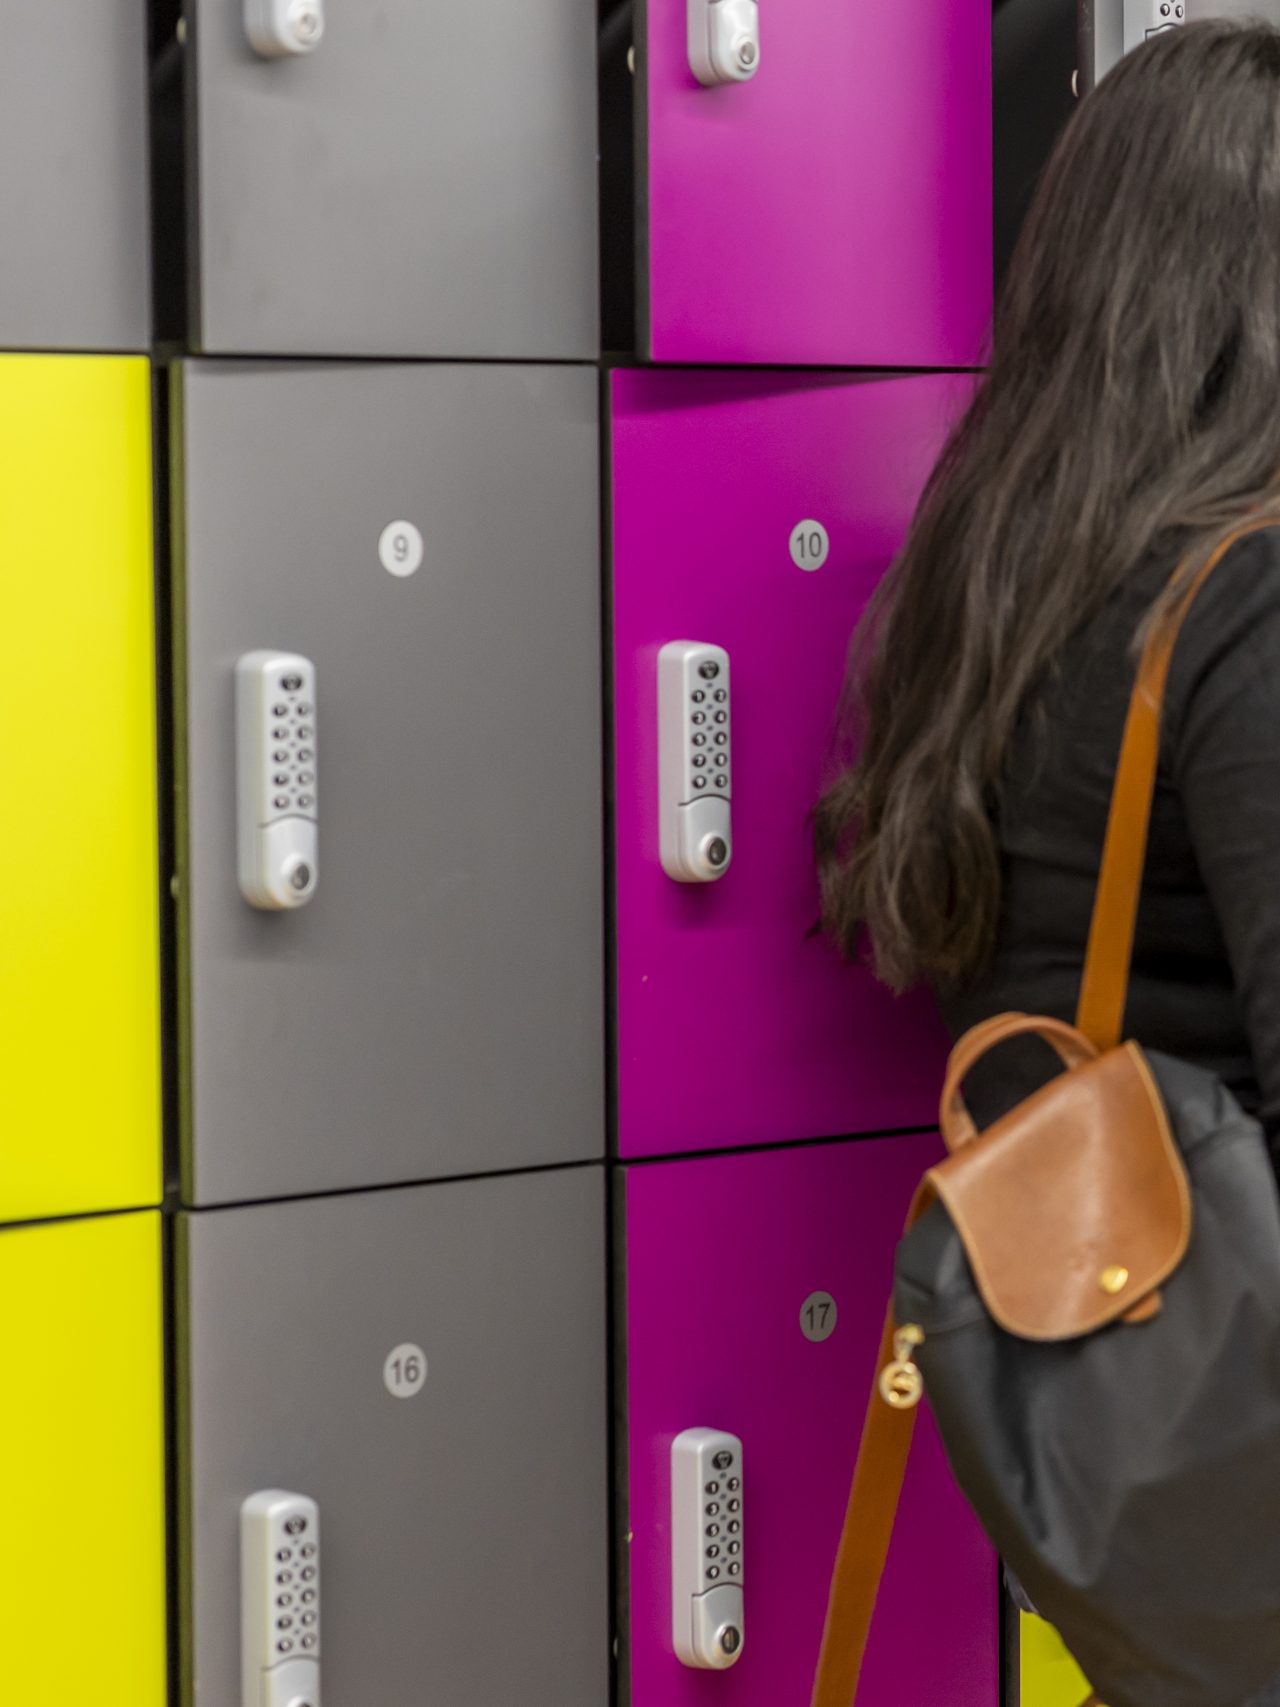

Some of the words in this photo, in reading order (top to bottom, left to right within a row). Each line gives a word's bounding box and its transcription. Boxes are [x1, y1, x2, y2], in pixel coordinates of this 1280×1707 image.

[393, 534, 409, 561] 9
[795, 532, 822, 558] 10
[806, 1302, 831, 1330] 17
[390, 1356, 420, 1385] 16
